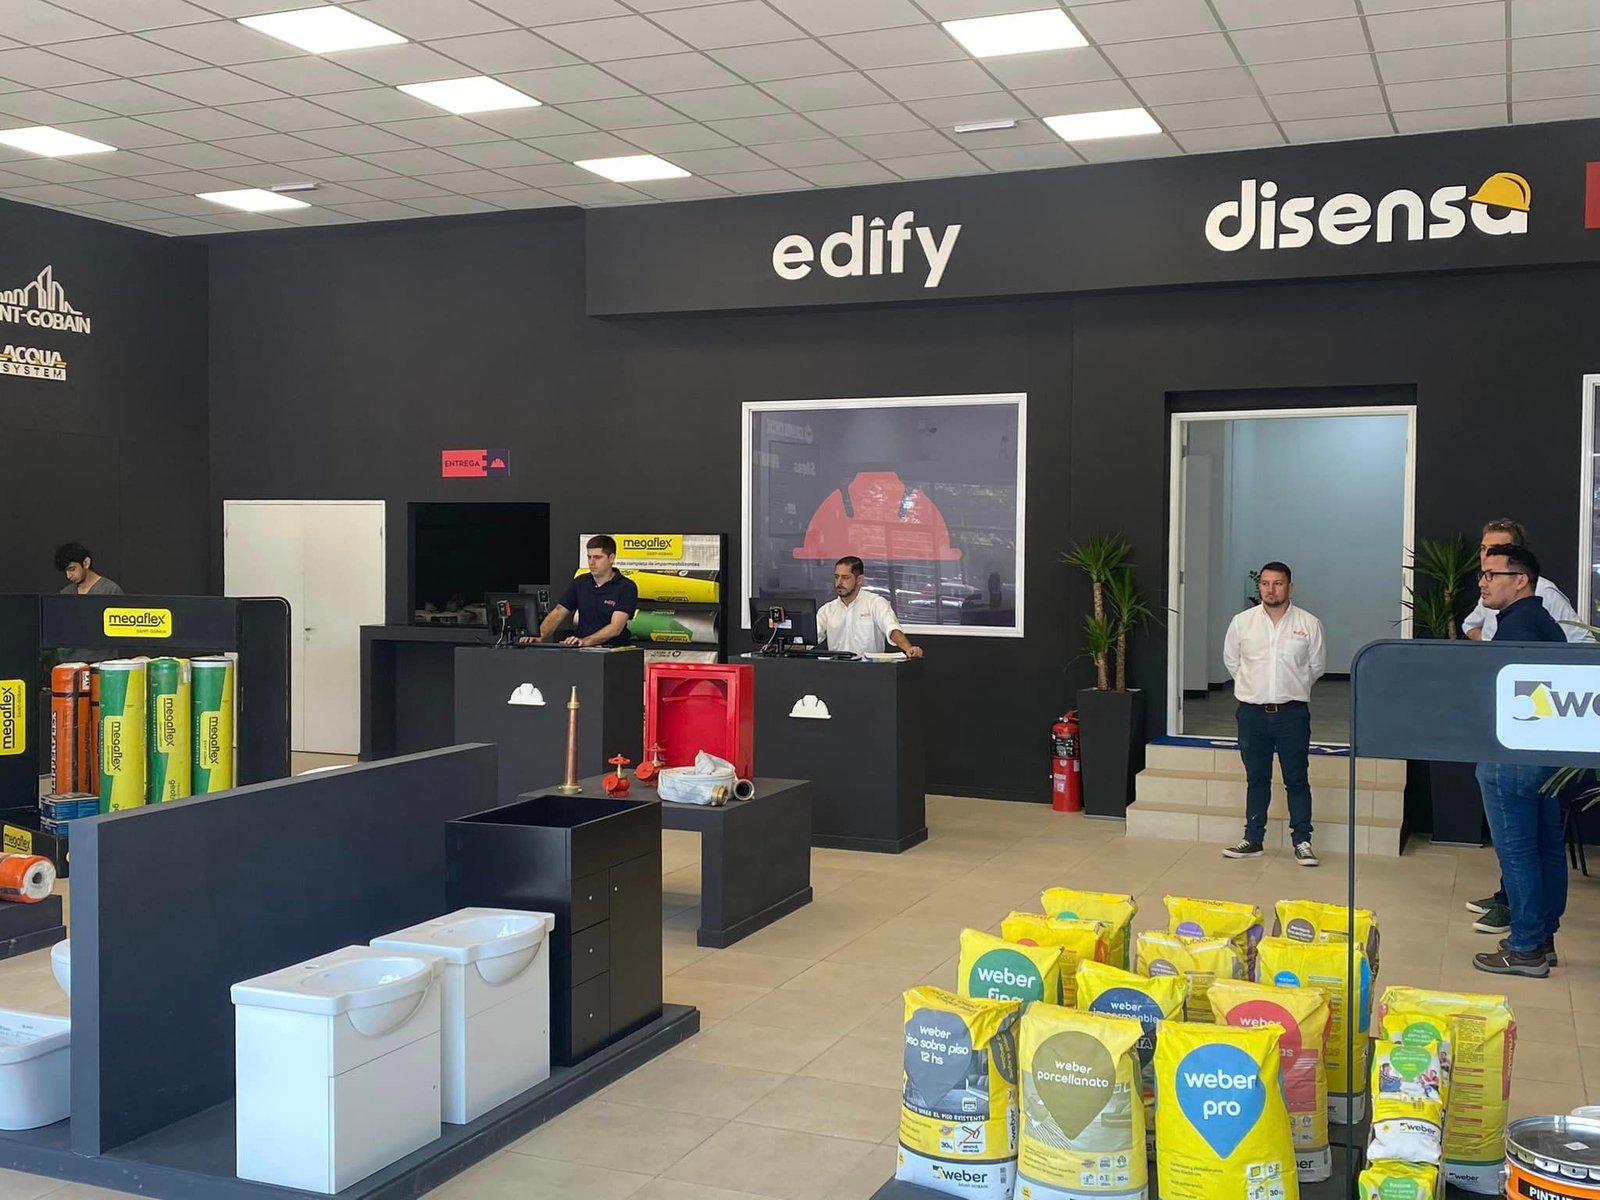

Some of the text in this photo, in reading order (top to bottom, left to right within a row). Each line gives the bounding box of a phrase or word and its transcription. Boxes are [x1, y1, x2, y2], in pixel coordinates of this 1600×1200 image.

[1205, 179, 1529, 252] disensa
[772, 211, 962, 288] edify
[3, 345, 66, 368] ACQUA
[3, 364, 62, 379] SYSTEM
[444, 460, 480, 468] ENTREGA
[623, 537, 672, 550] megaflex
[109, 613, 166, 626] megaflex
[0, 687, 15, 749] megaflex
[164, 697, 175, 746] megaflex
[111, 721, 122, 771] megaflex
[209, 716, 220, 764] megaflex
[4, 833, 31, 851] megaflex
[978, 967, 1036, 988] weber
[1110, 1002, 1142, 1012] weber
[920, 1026, 951, 1039] weber
[920, 1039, 947, 1052] sobre
[948, 1043, 968, 1055] piso
[920, 1051, 944, 1065] 12 hs
[1055, 1060, 1092, 1074] weber
[1037, 1070, 1109, 1088] porcellanato
[1184, 1069, 1257, 1090] weber
[1203, 1100, 1241, 1120] pro
[1407, 1124, 1436, 1136] weber
[942, 1169, 988, 1183] weber
